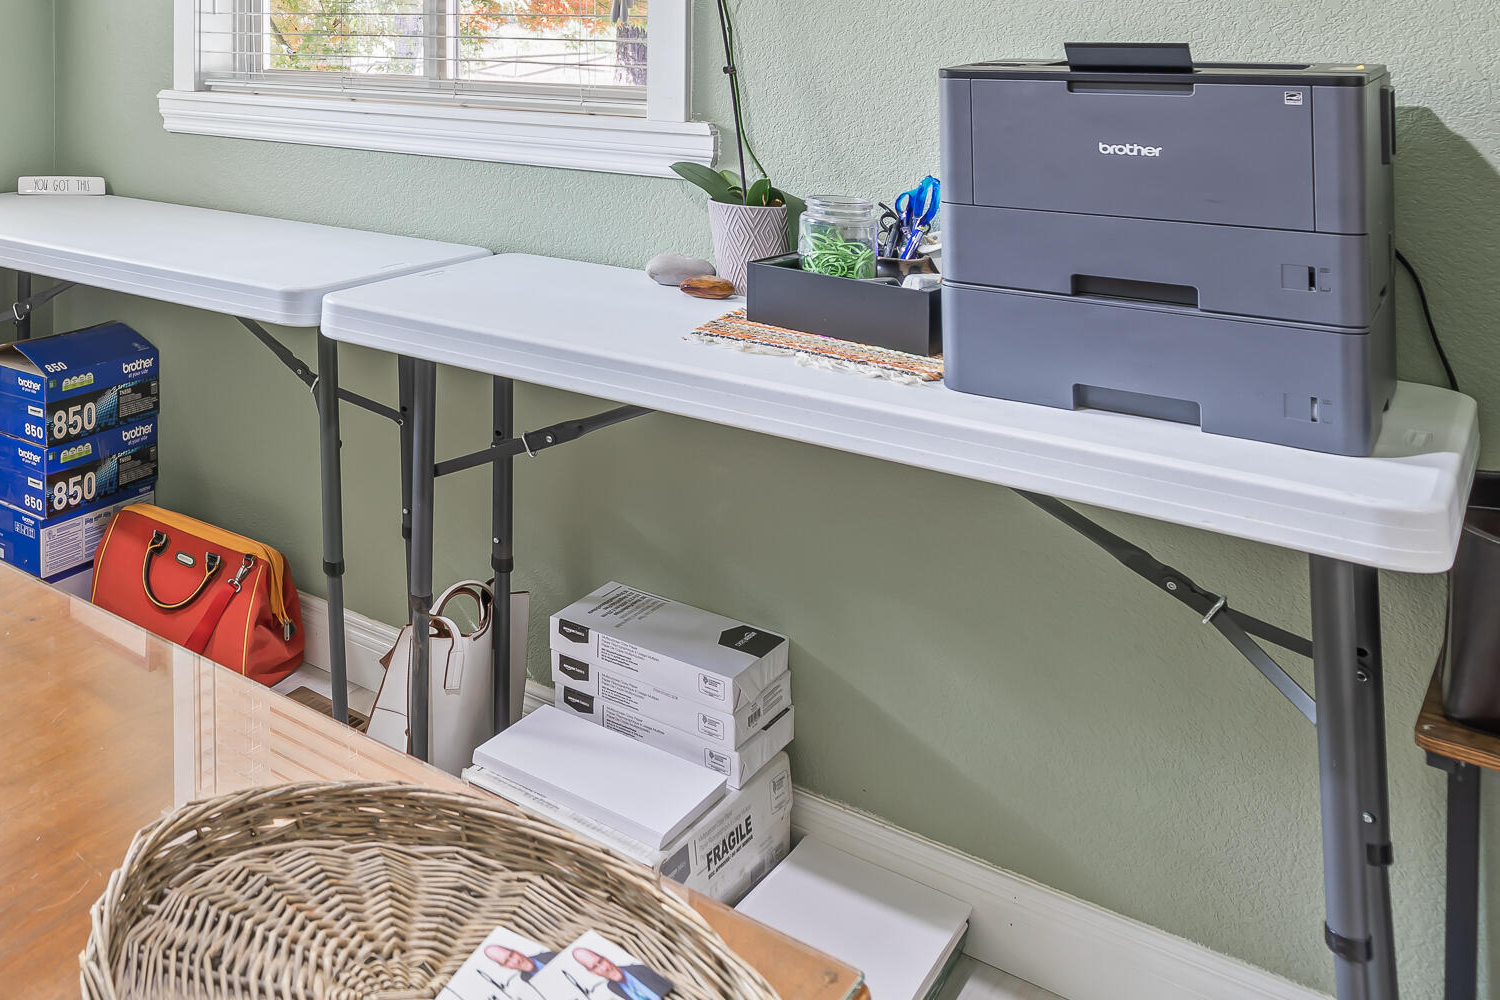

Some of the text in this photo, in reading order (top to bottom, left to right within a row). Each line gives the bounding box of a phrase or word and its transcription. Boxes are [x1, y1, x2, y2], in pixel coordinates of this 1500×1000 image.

[1098, 141, 1163, 157] brother
[33, 178, 48, 191] YOU
[53, 179, 70, 191] GOT
[44, 361, 68, 373] 850
[122, 357, 154, 374] brother
[17, 377, 41, 391] brother
[53, 402, 97, 439] 850
[24, 422, 44, 439] 850
[122, 423, 153, 441] brother
[18, 447, 42, 463] brother
[53, 471, 97, 511] 850
[24, 494, 43, 512] 850
[706, 815, 753, 872] FRAGILE
